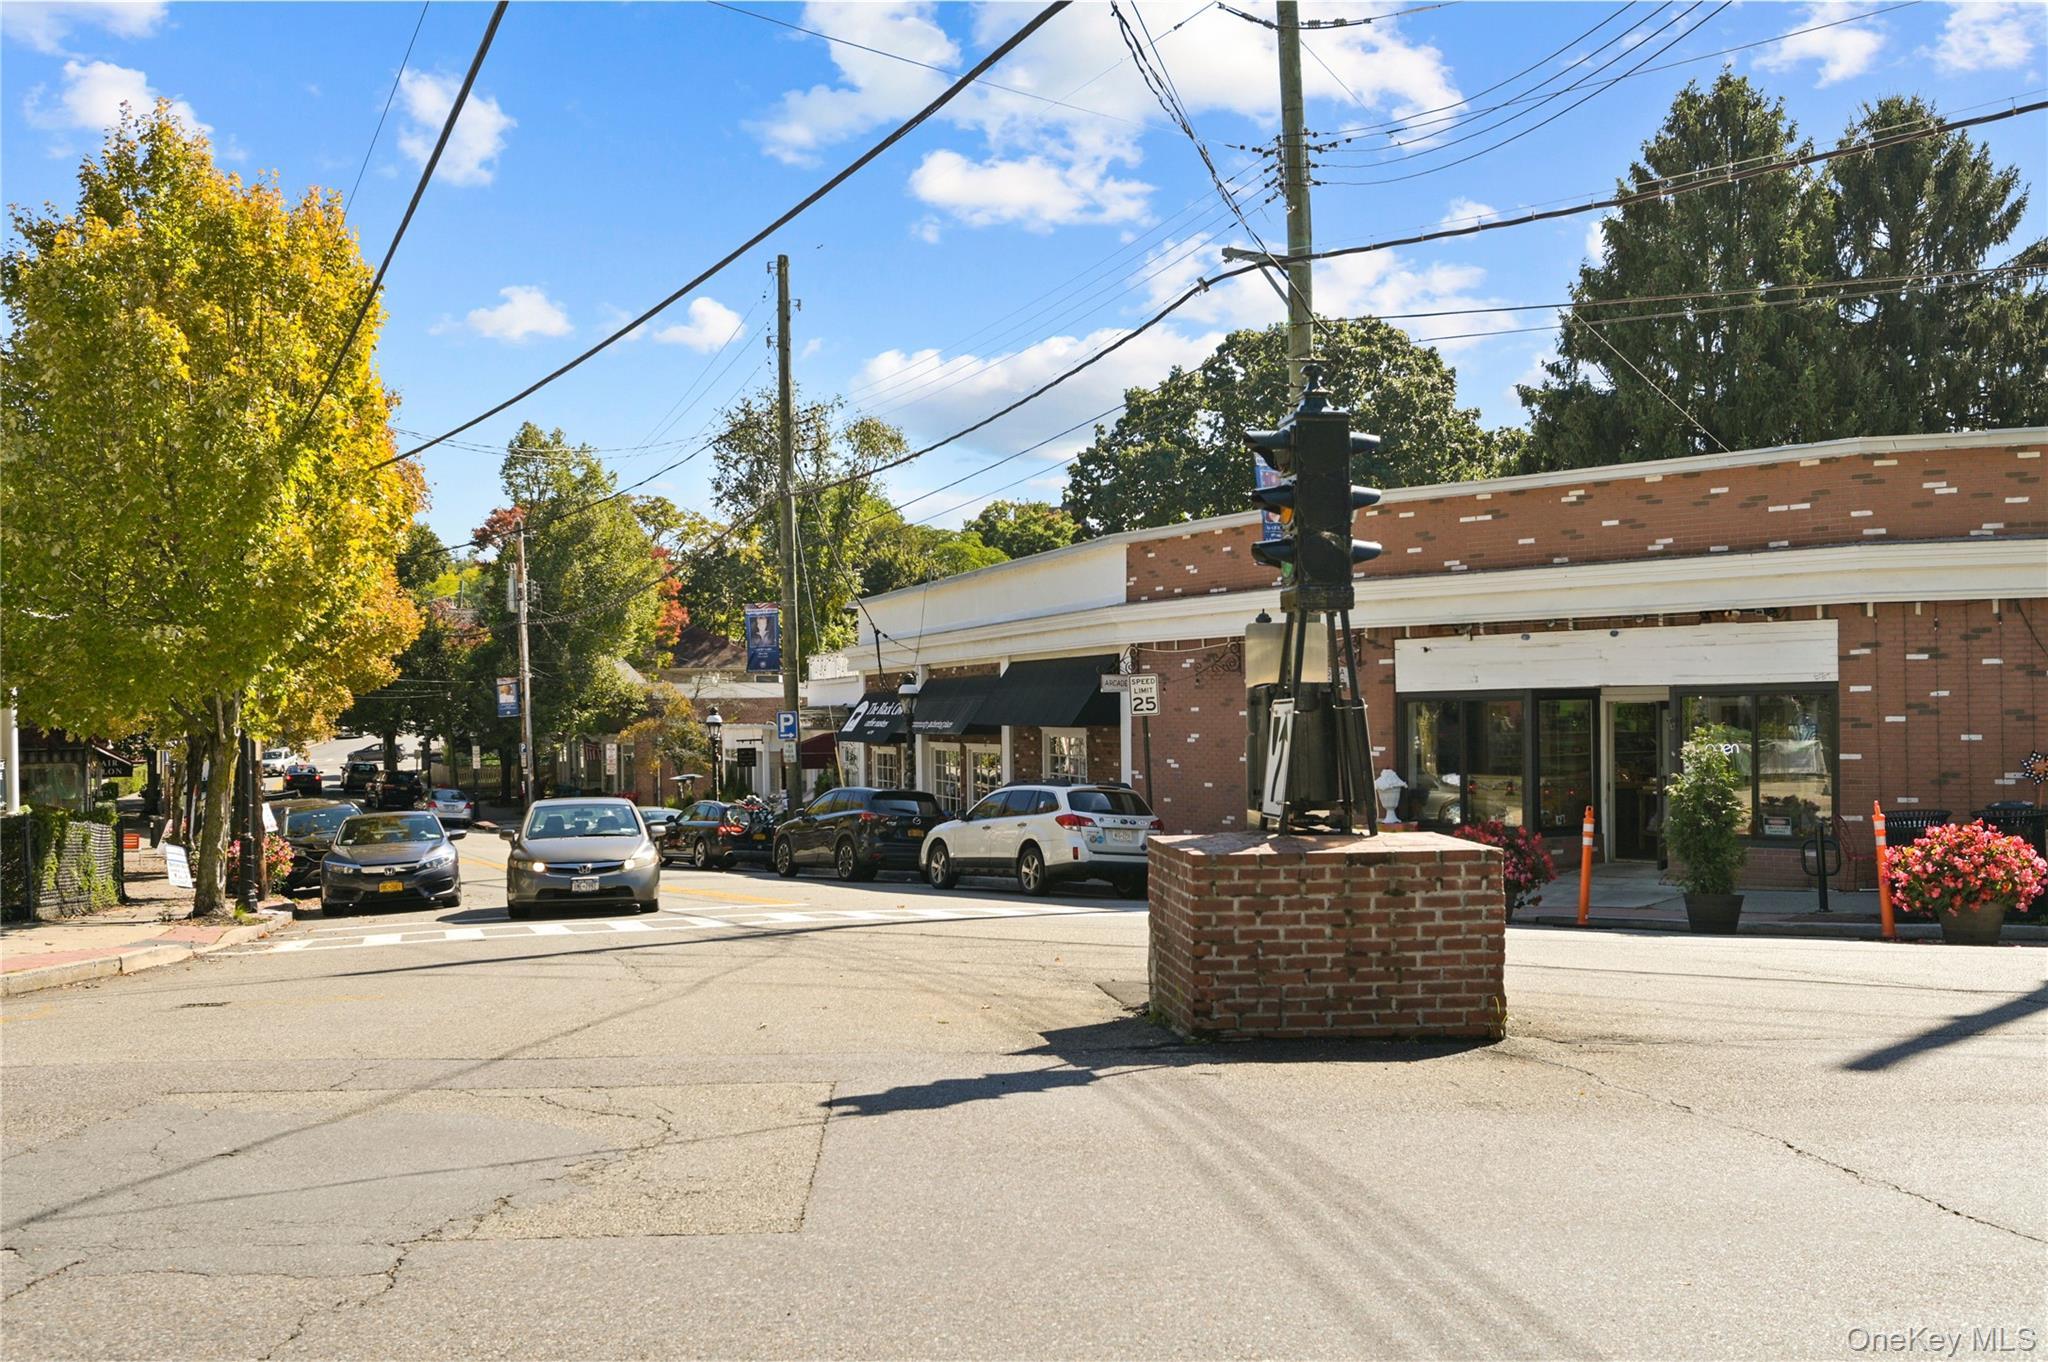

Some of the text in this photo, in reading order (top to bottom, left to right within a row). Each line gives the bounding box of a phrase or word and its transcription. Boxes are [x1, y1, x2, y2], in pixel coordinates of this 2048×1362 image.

[1131, 677, 1155, 685] SPEED
[866, 702, 879, 715] The
[1132, 696, 1156, 711] 25
